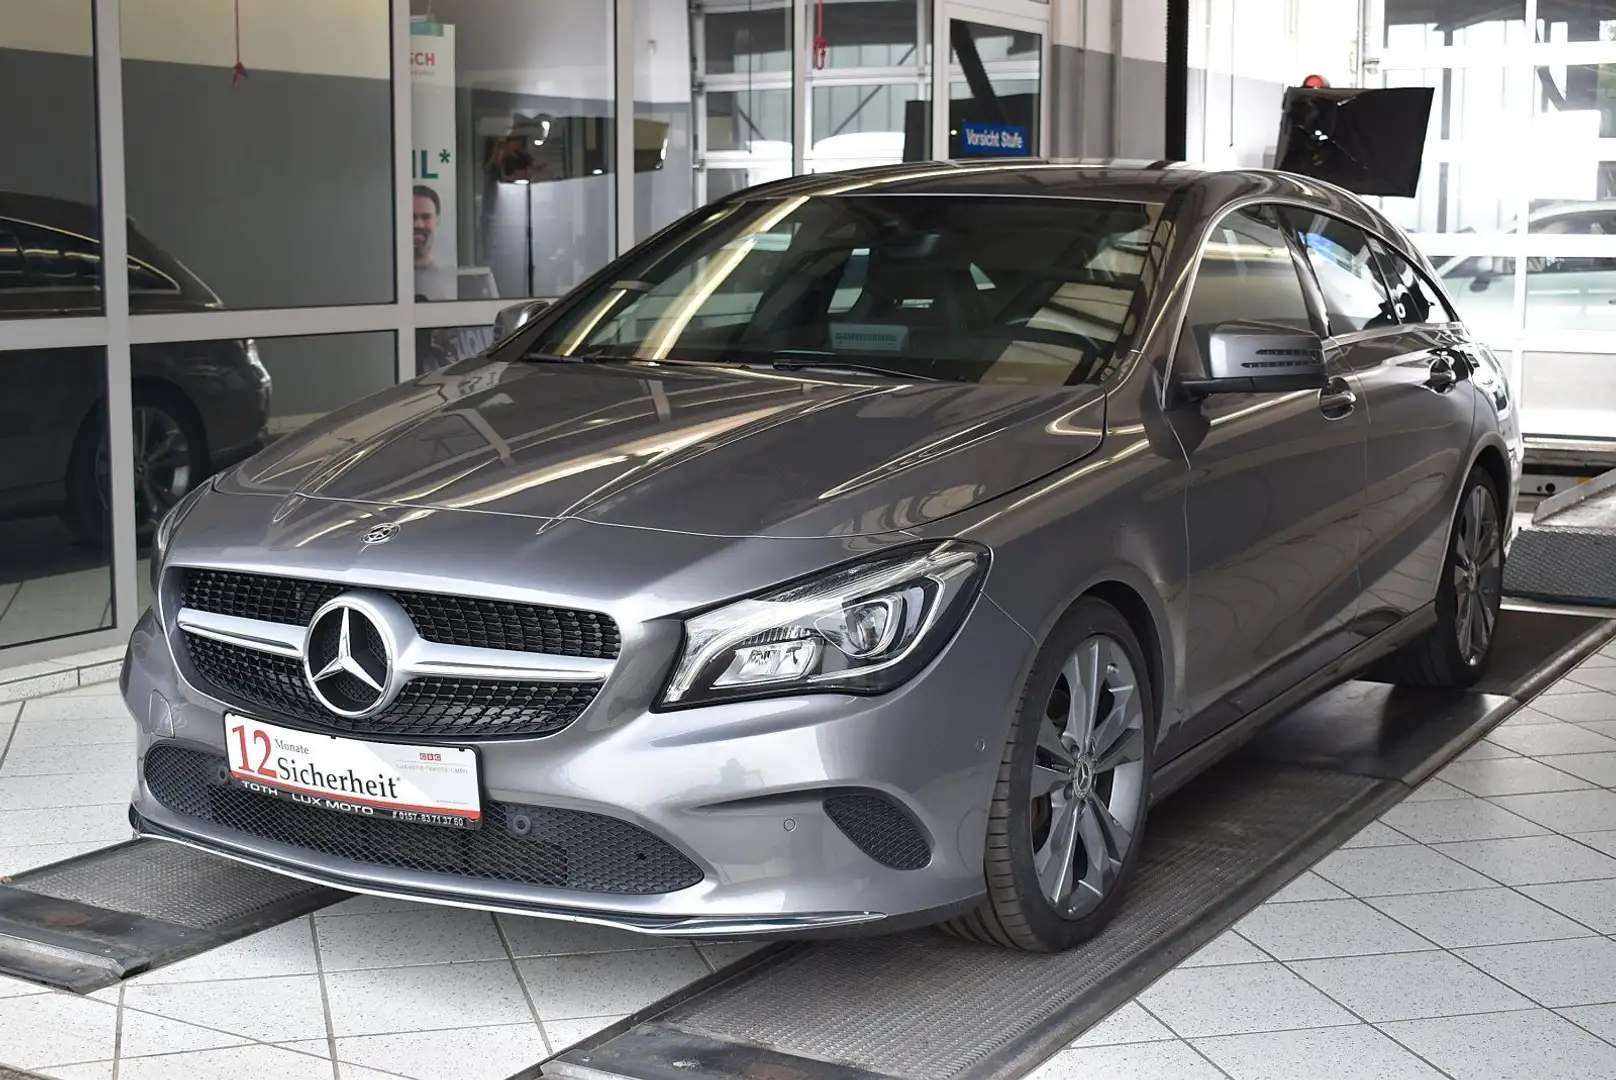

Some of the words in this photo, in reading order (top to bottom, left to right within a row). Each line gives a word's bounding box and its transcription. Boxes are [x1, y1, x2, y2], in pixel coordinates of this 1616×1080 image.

[965, 128, 1000, 148] Vorsicht
[1001, 131, 1023, 149] Stufe
[232, 725, 277, 779] 12
[275, 738, 310, 755] Monate
[277, 757, 398, 799] Sicherheit
[241, 780, 278, 796] TOTH
[291, 793, 322, 807] LUX
[325, 800, 374, 816] MOTO
